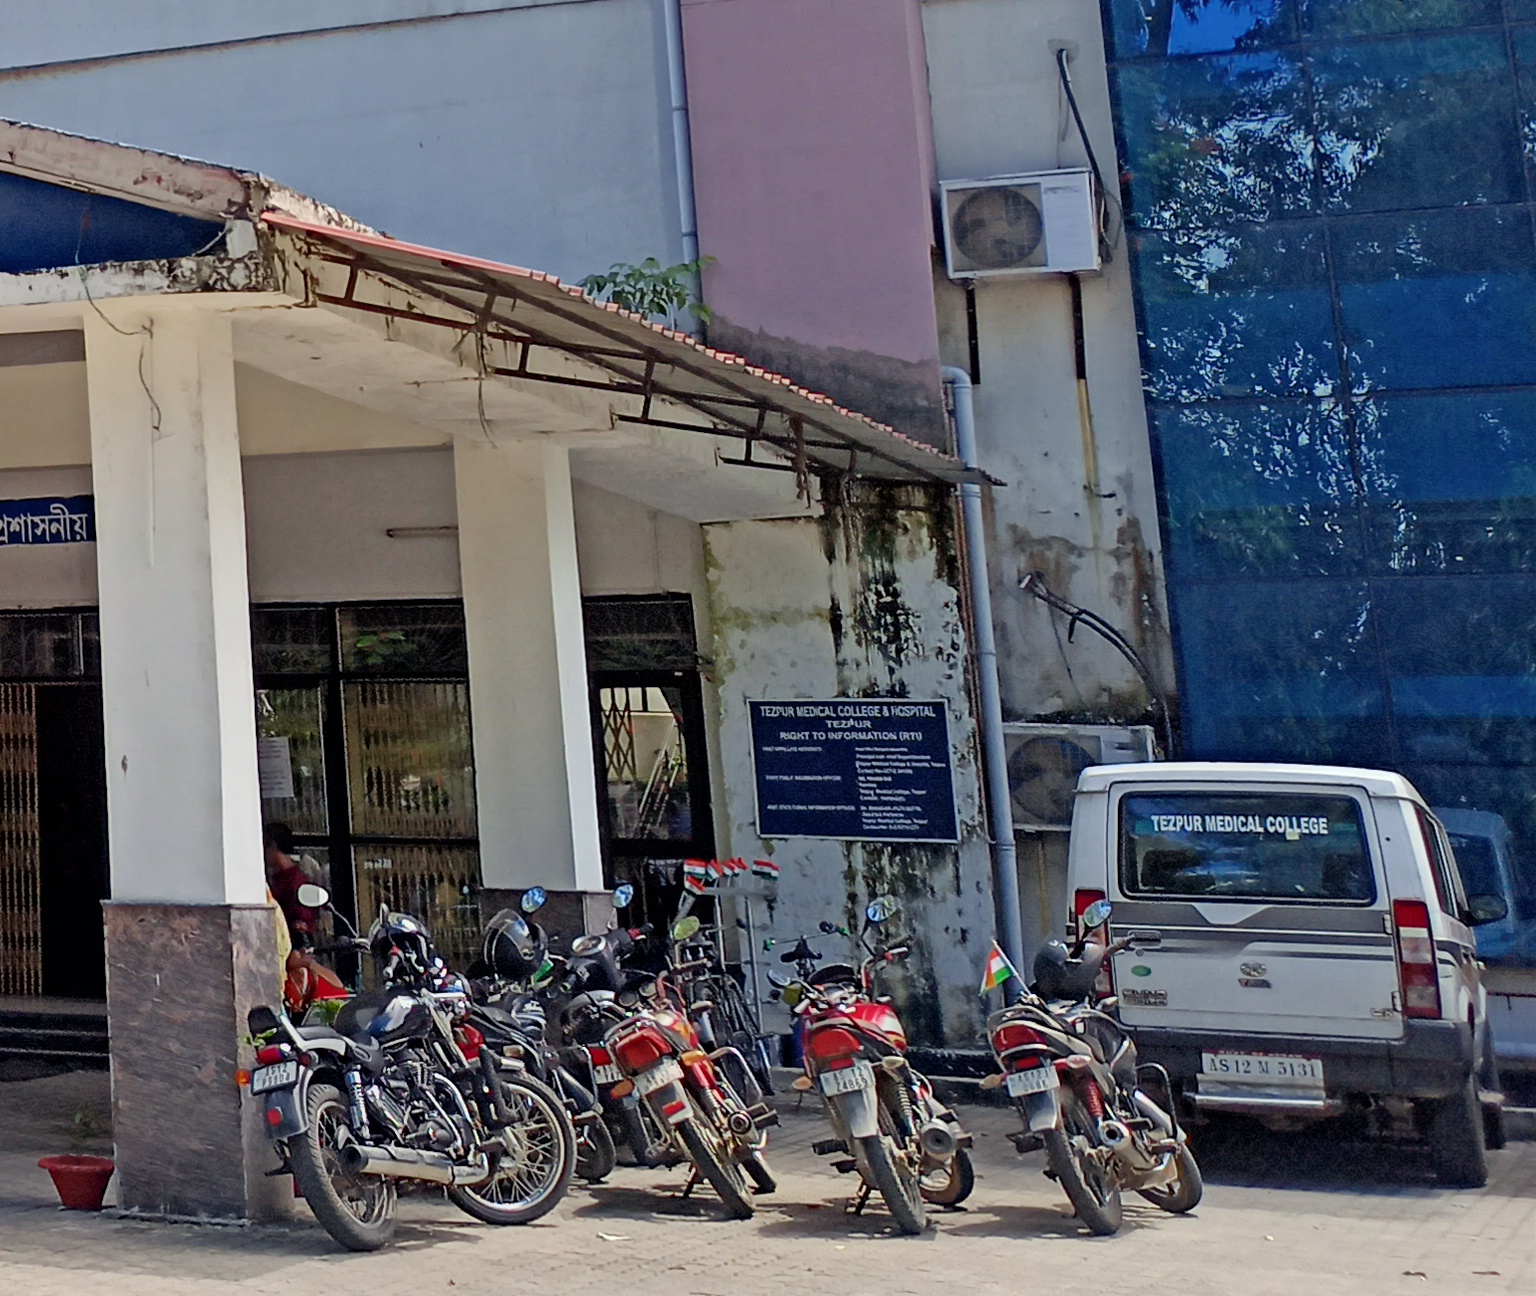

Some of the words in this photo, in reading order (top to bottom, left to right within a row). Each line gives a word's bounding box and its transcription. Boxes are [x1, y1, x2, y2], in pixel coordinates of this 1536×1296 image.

[759, 705, 795, 718] TEZPUR
[796, 705, 837, 718] MEDICAL
[838, 705, 881, 718] COLLEGE
[882, 705, 890, 717] &
[891, 705, 937, 718] HOSPITAL
[825, 718, 872, 729] TEZPUR
[779, 730, 811, 741] RIGHT
[812, 730, 827, 741] TO
[828, 730, 898, 741] INFORMATION
[899, 730, 923, 741] (RTI)
[1150, 814, 1204, 833] TEZPUR
[1205, 814, 1265, 834] MEDICAL
[1266, 815, 1329, 835] COLLEGE
